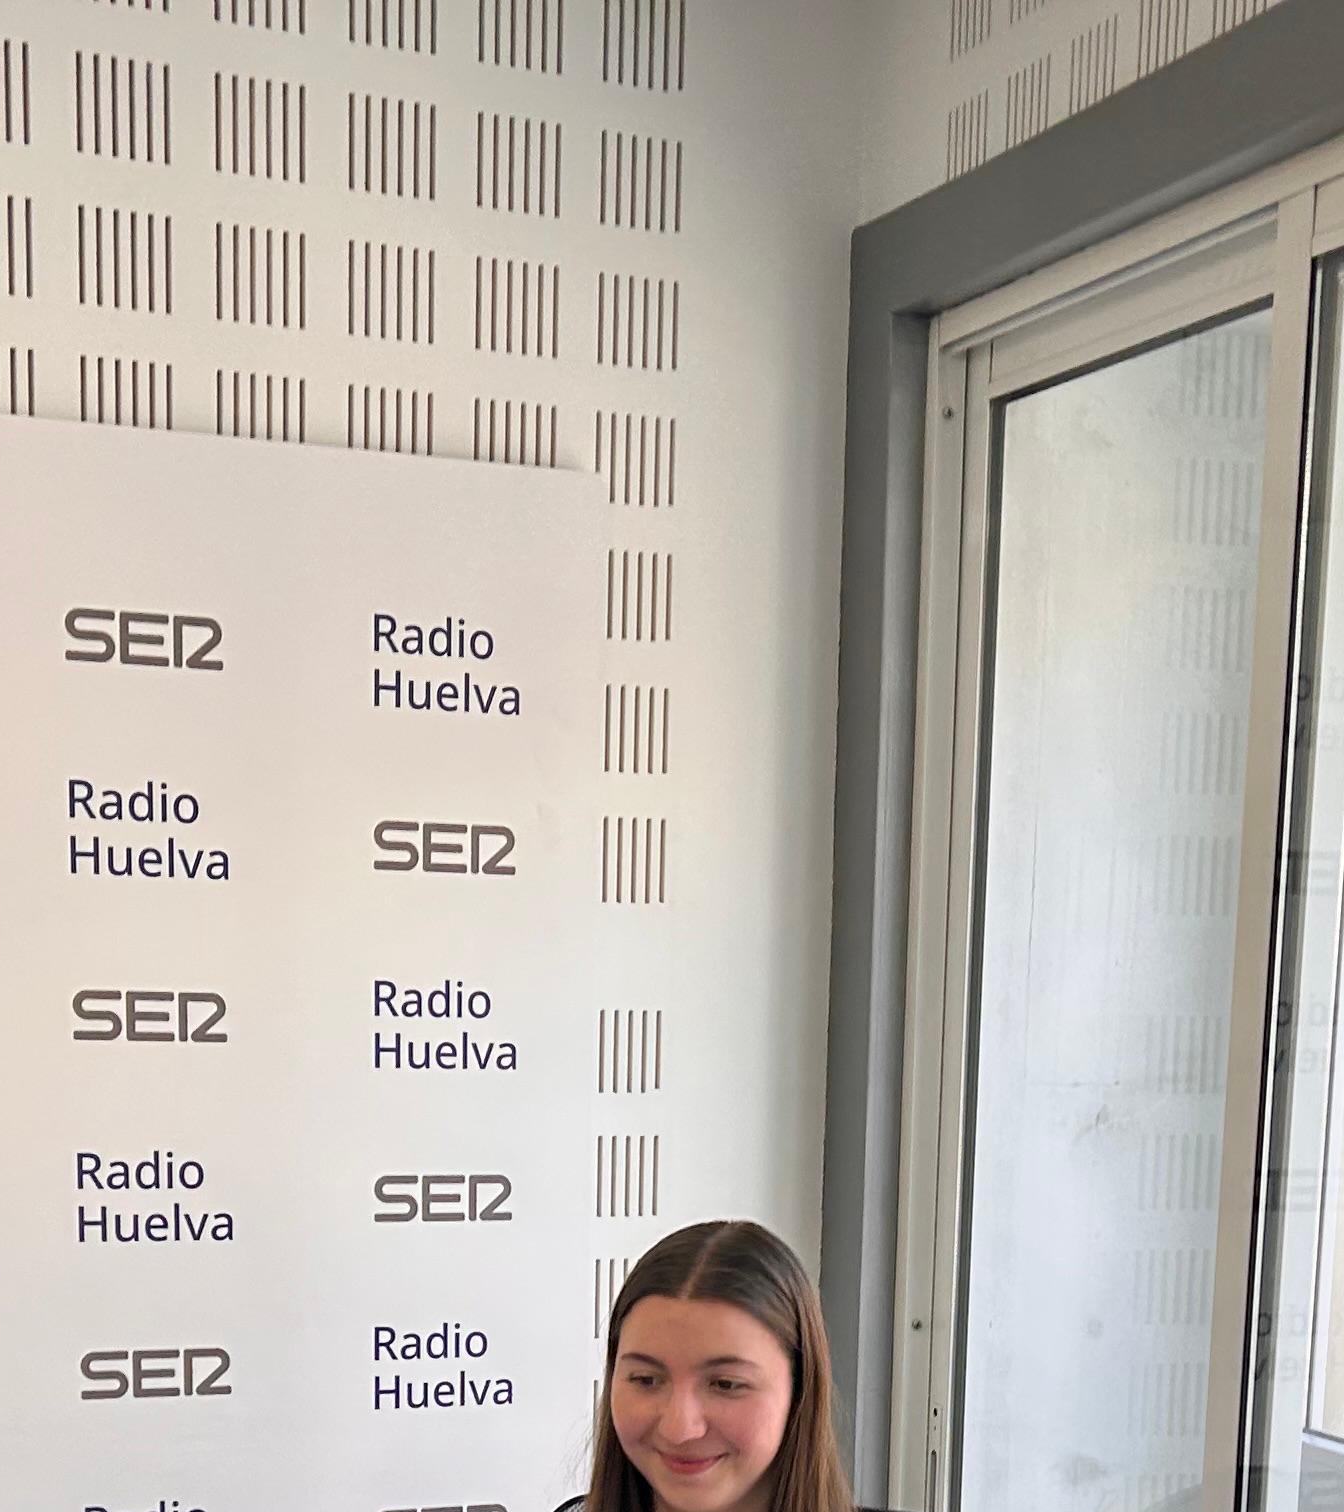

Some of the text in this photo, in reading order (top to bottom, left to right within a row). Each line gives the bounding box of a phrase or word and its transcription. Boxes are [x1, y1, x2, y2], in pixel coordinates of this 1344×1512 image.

[63, 606, 225, 673] SER
[372, 611, 495, 662] Radio
[372, 666, 522, 717] Huelva
[67, 777, 201, 826] Radio
[68, 832, 231, 882] Huelva
[372, 819, 518, 877] SER
[71, 988, 230, 1045] SER
[373, 978, 493, 1021] Radio
[373, 1030, 518, 1072] Huelva
[75, 1148, 206, 1192] Radio
[76, 1201, 235, 1244] Huelva
[372, 1173, 514, 1224] SER
[372, 1321, 489, 1363] Radio
[79, 1346, 234, 1402] SER
[373, 1369, 515, 1412] Huelva
